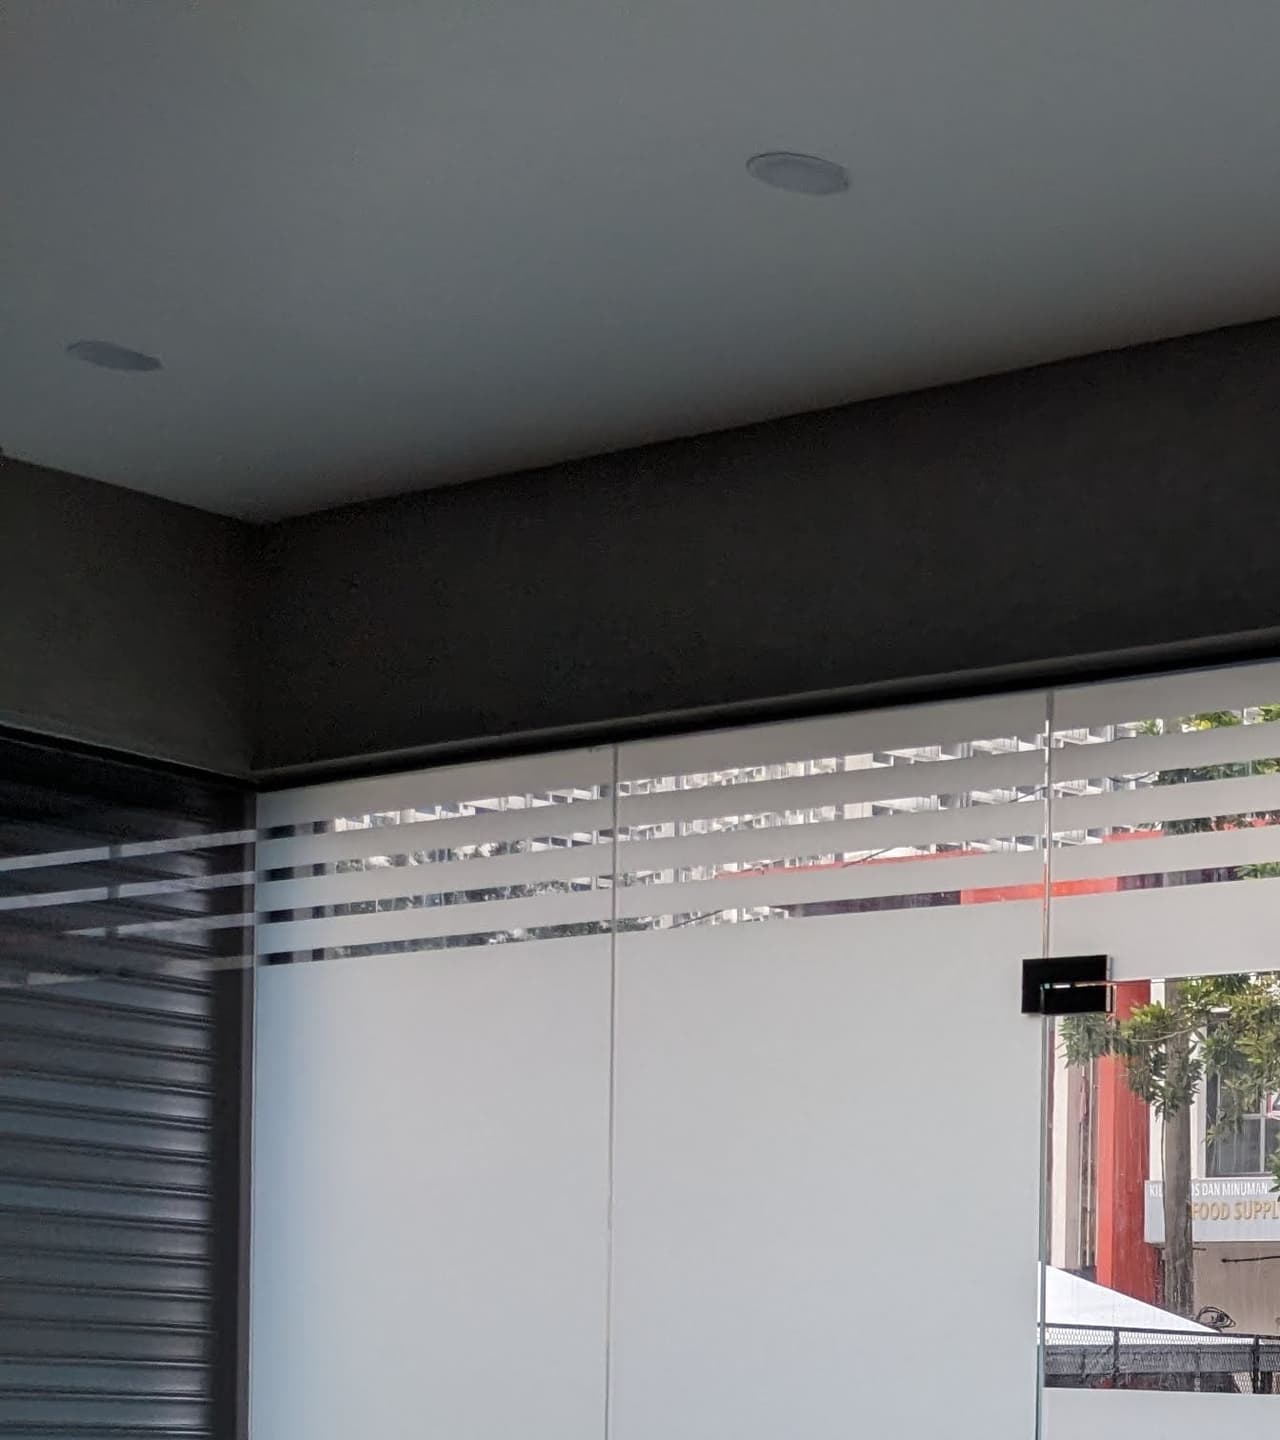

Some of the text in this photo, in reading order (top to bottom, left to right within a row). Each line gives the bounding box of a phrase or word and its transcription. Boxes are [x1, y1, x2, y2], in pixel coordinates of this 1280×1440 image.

[1202, 1183, 1220, 1197] DAN
[1222, 1182, 1269, 1197] MINUMAN
[1189, 1202, 1230, 1221] FOOD
